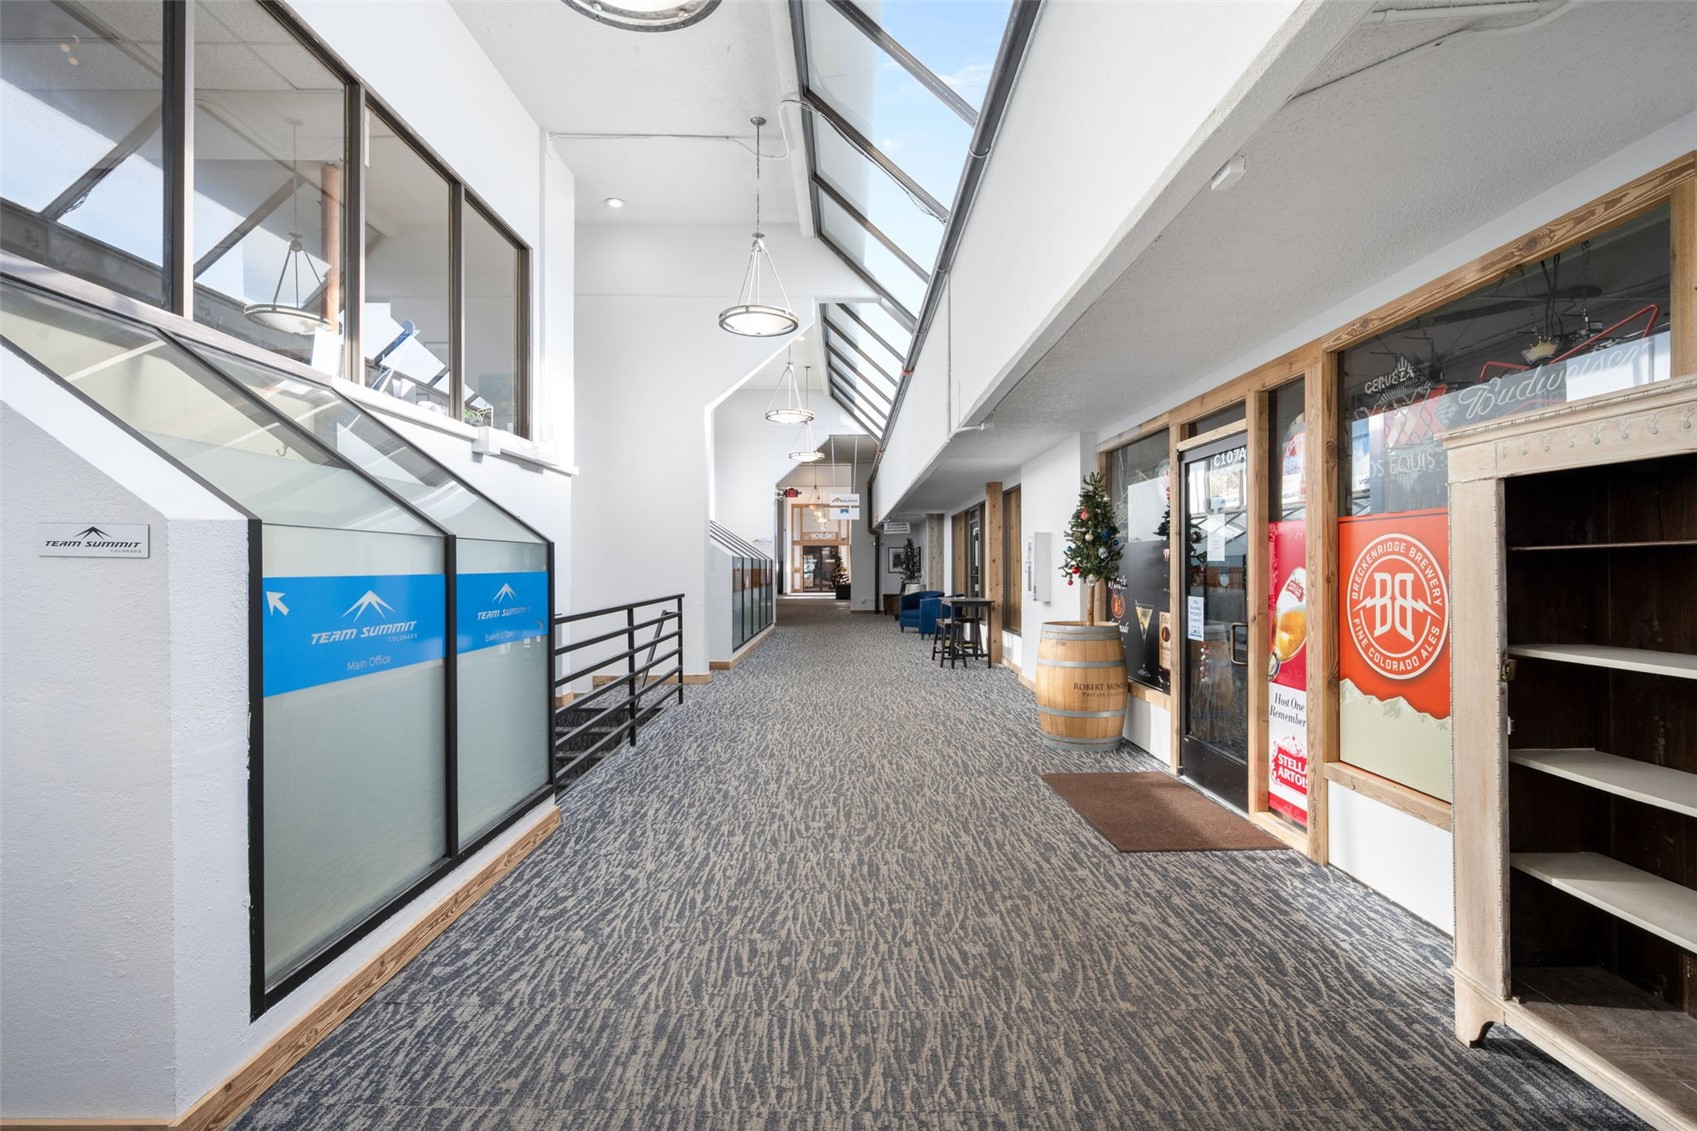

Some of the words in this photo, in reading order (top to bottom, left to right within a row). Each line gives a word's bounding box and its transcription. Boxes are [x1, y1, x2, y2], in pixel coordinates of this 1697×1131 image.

[1364, 367, 1415, 394] CERVEZA
[1389, 451, 1436, 474] EQUIS
[1352, 541, 1407, 600] BRECKENRIDGE
[1408, 546, 1443, 607] BREWERY
[477, 610, 500, 621] TEAM
[311, 628, 358, 645] TEAM
[360, 621, 417, 638] SUMMIT
[1353, 617, 1369, 648] FINE
[1368, 648, 1420, 672] COLORADO
[1421, 625, 1441, 660] ALES
[347, 660, 368, 672] Main
[369, 655, 392, 667] Office
[1073, 682, 1104, 691] ROBERT
[1106, 682, 1126, 690] MOND
[1274, 692, 1290, 707] Host
[1291, 697, 1305, 713] One
[1269, 705, 1307, 728] Remember
